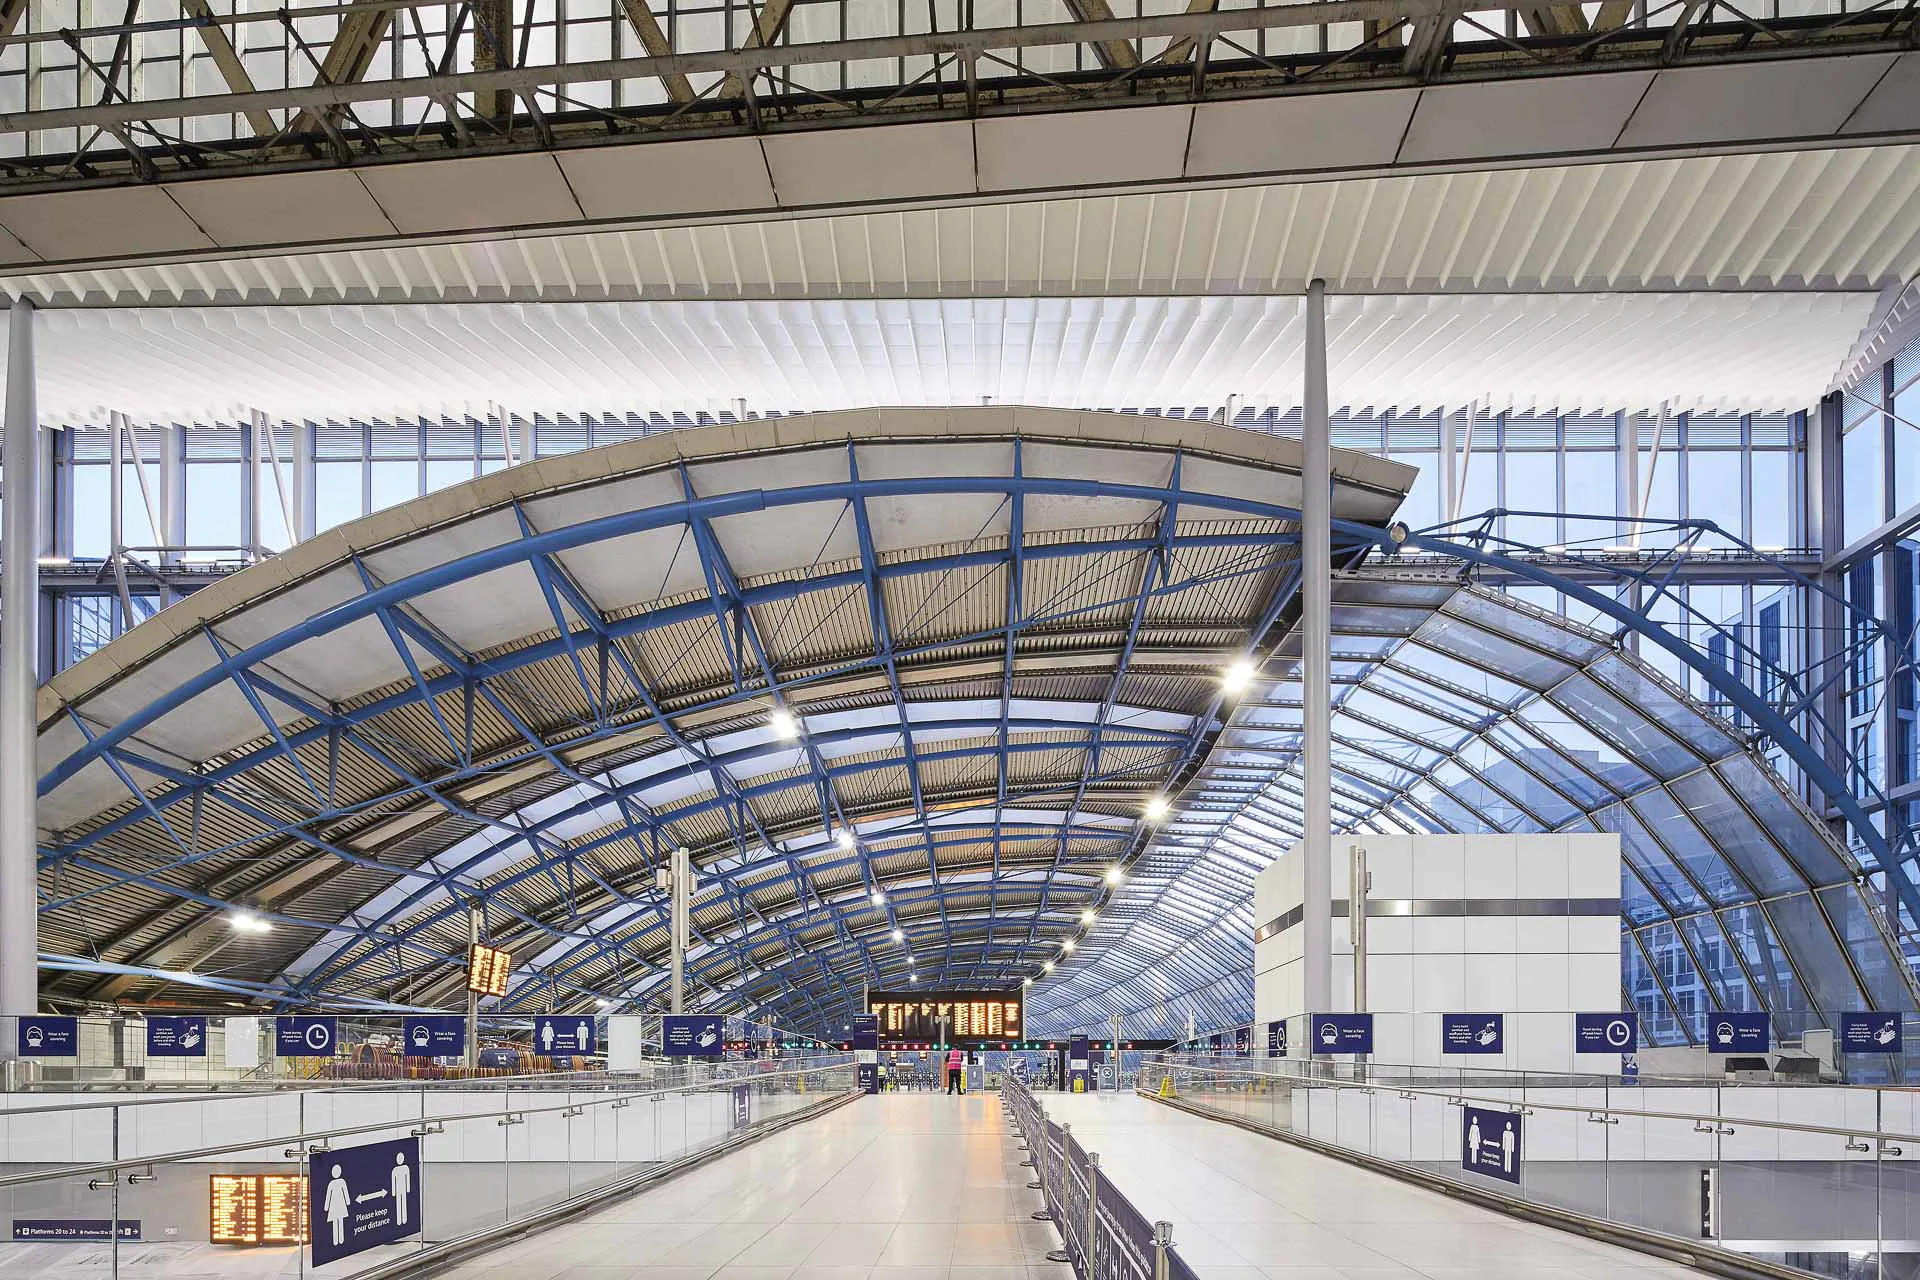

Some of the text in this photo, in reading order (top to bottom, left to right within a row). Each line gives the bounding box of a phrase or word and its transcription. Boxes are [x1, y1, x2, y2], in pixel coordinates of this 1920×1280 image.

[356, 1208, 387, 1222] Please keep
[354, 1218, 390, 1236] your distance
